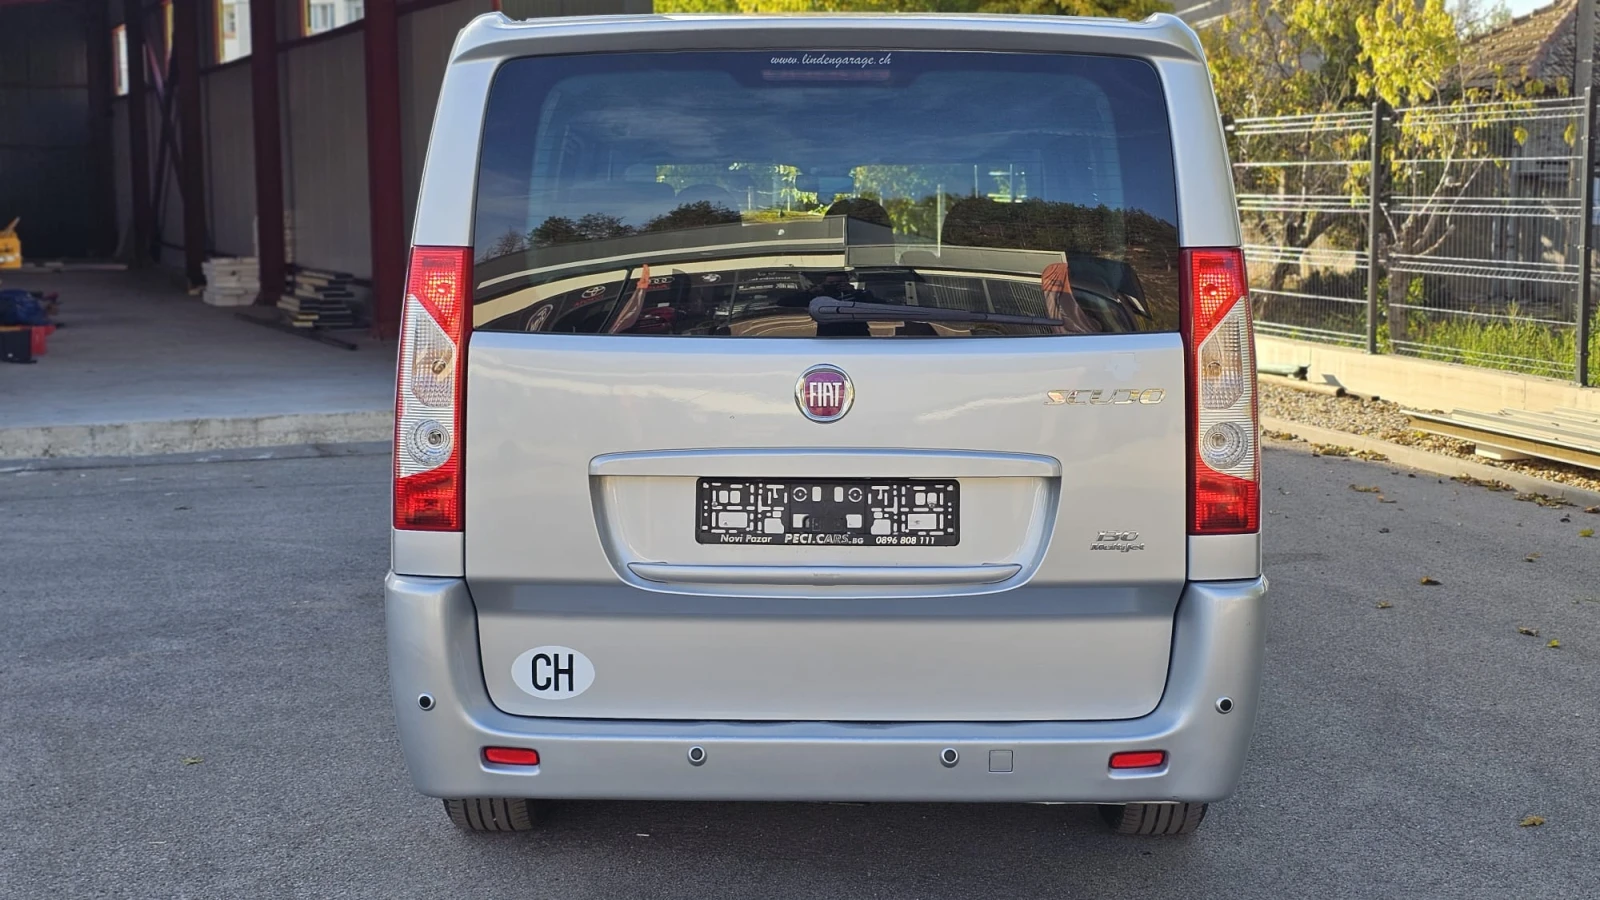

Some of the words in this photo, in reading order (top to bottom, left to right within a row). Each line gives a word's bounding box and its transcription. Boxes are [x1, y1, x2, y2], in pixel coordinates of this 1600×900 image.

[770, 53, 892, 69] www.lindengarage.ch
[809, 381, 842, 407] FIAT
[720, 534, 744, 543] Novi
[745, 534, 772, 543] Pazar
[875, 536, 898, 544] 0896
[900, 536, 917, 545] 808
[920, 536, 935, 545] 111
[531, 653, 574, 692] CH
